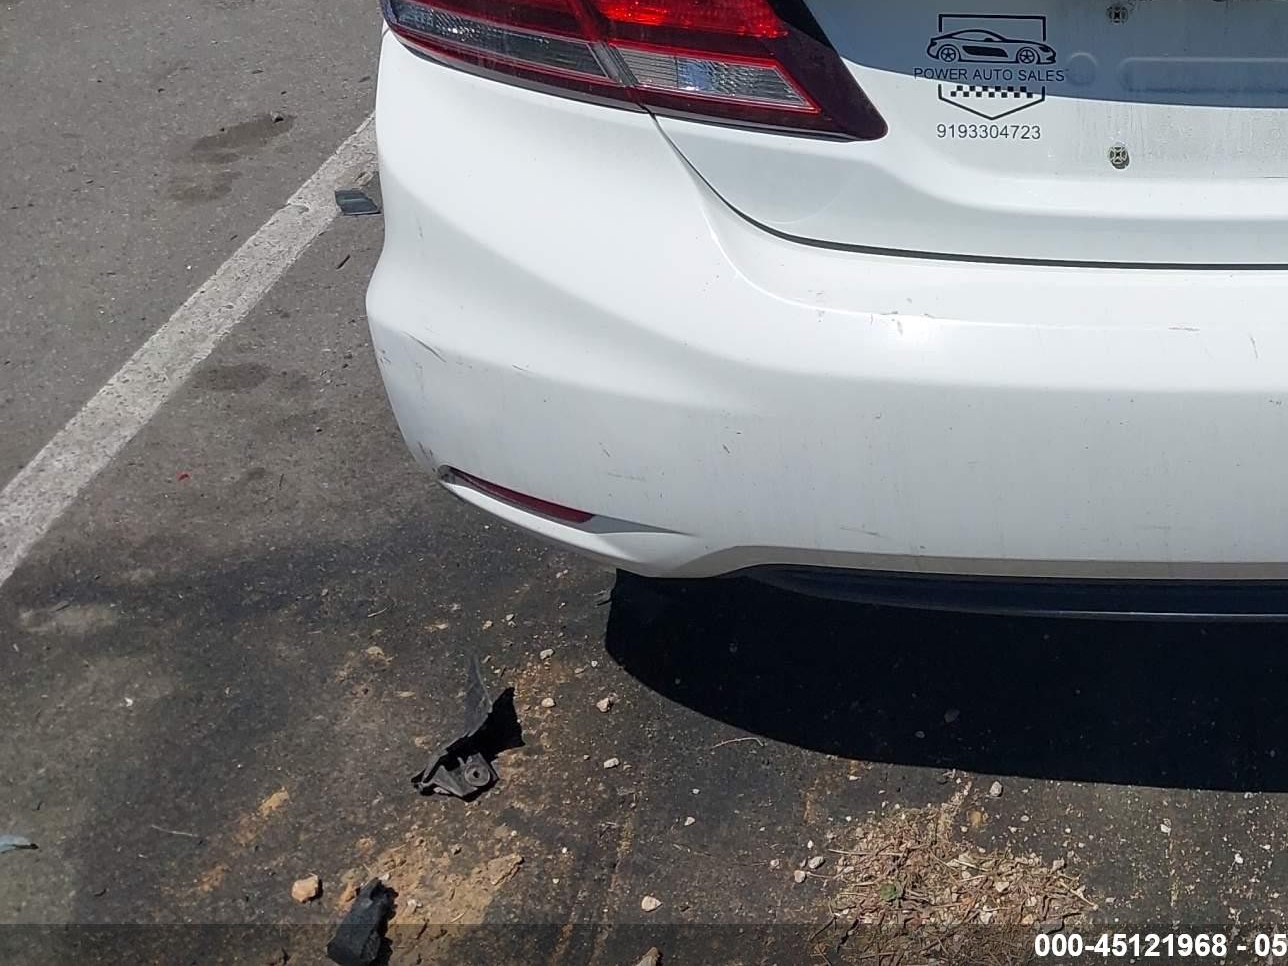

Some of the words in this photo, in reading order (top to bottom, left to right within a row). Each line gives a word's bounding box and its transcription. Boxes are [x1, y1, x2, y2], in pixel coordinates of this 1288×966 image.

[913, 67, 968, 81] POWER
[972, 68, 1013, 82] AUTO
[1017, 69, 1065, 82] SALES
[936, 123, 1042, 140] 9193304723
